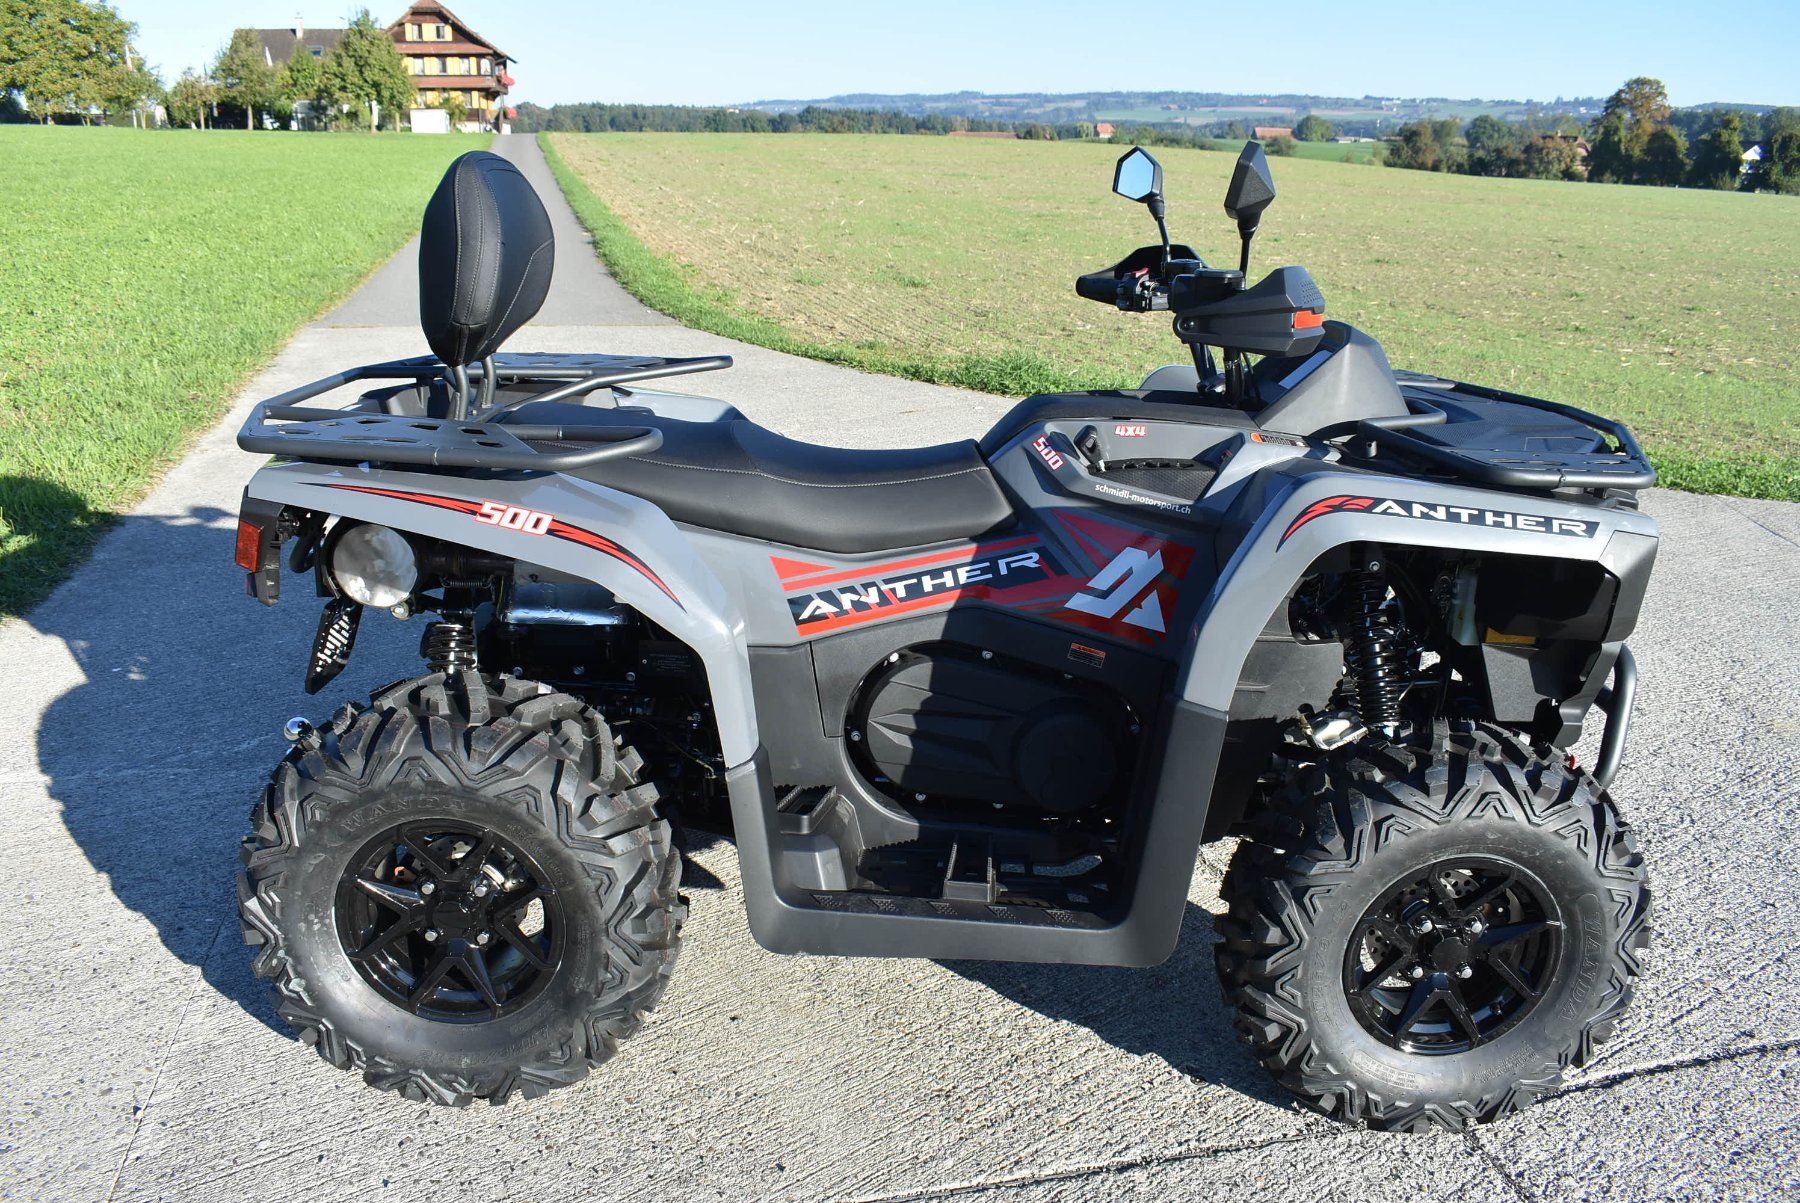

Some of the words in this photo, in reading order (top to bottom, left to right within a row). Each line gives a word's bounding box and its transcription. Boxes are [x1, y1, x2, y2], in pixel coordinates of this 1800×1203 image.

[1033, 436, 1063, 470] 500
[1095, 483, 1191, 514] schmidli-motorsport.ch
[475, 501, 554, 535] 500
[1372, 500, 1587, 537] ANTHER
[798, 551, 1041, 619] ANTHER
